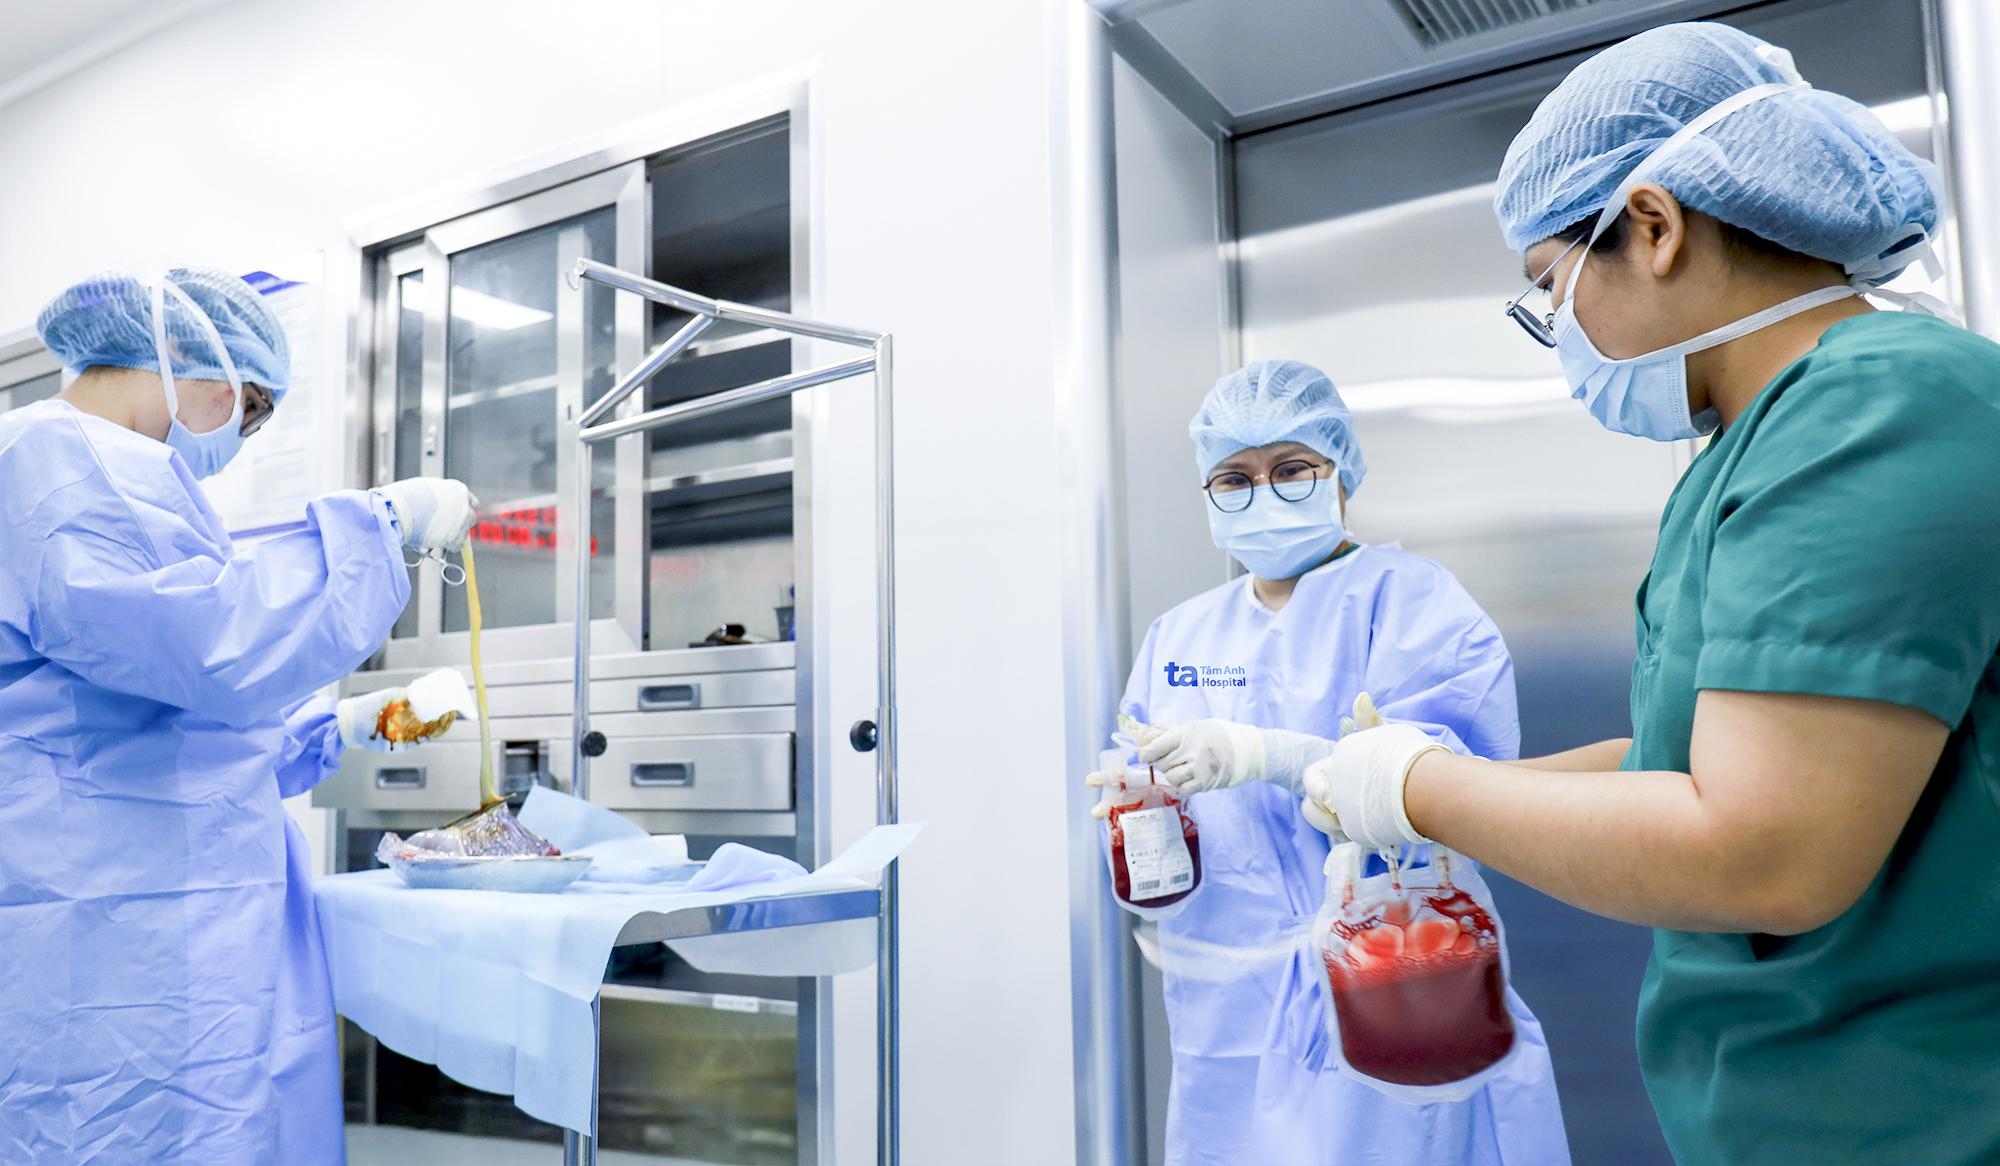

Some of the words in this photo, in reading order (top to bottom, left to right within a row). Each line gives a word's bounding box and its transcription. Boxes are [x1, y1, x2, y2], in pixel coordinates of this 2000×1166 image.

[1163, 661, 1198, 687] ta
[1224, 665, 1245, 675] Anh
[1202, 677, 1246, 689] Hospital
